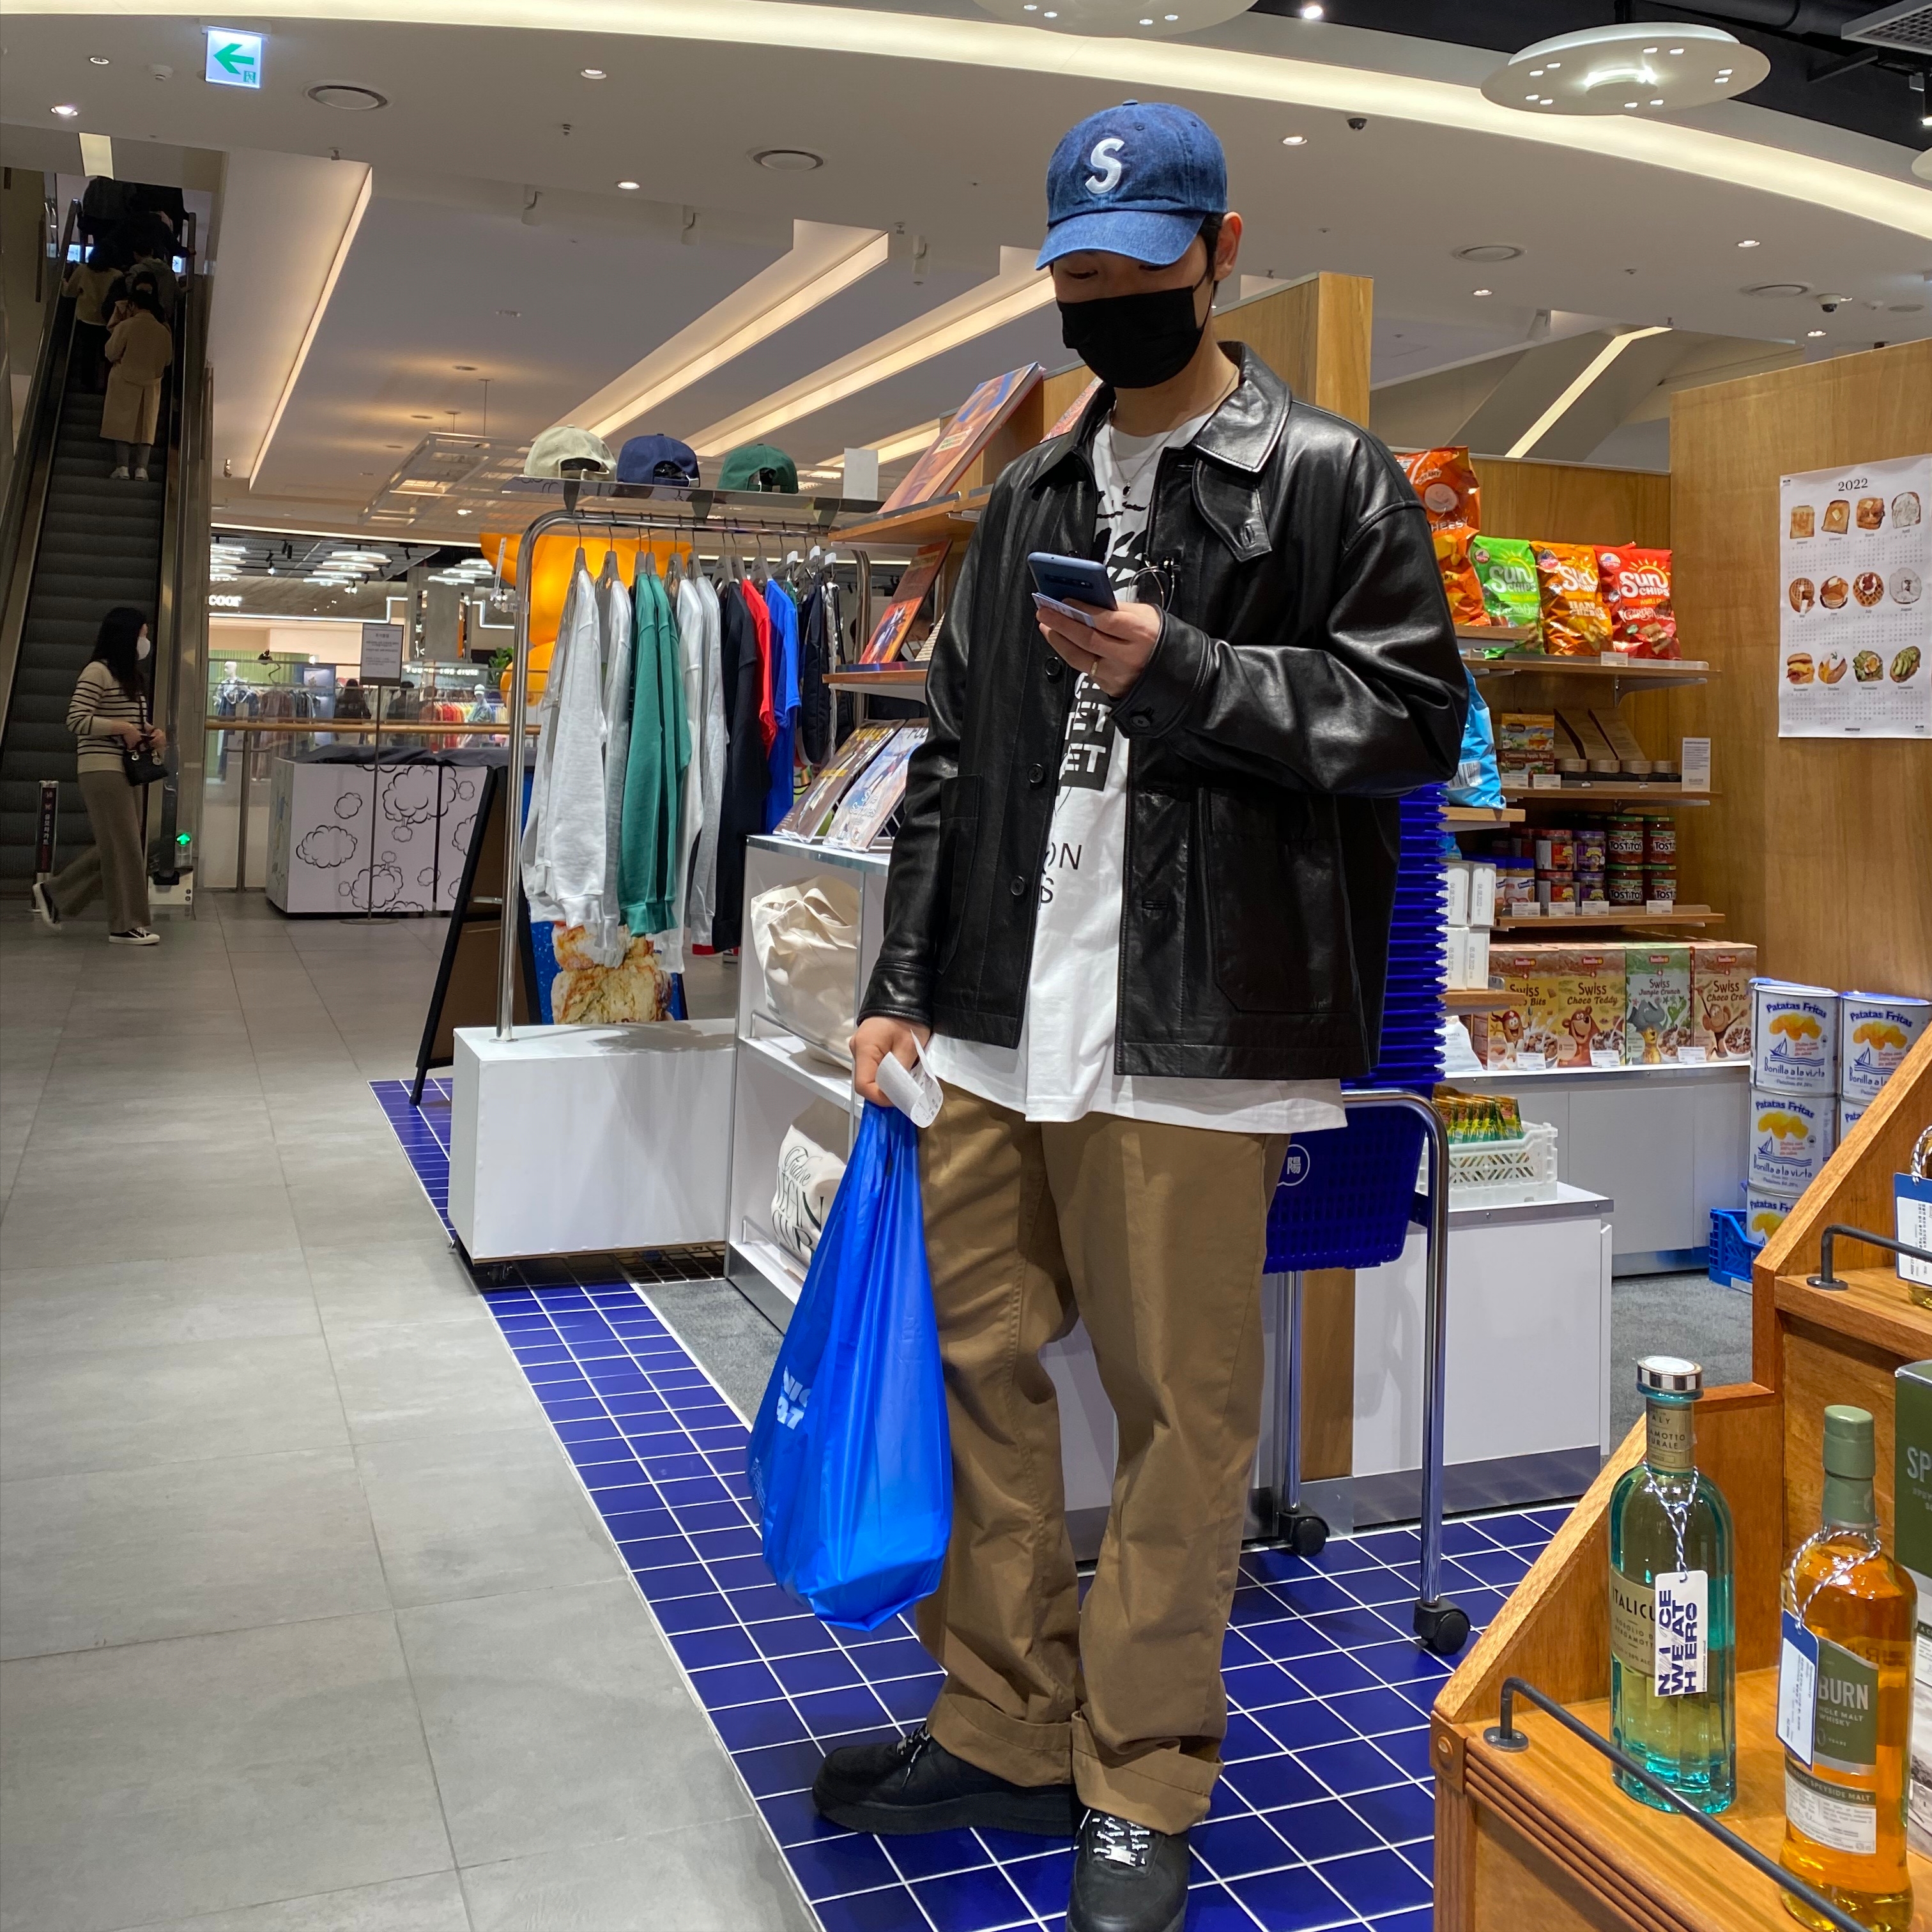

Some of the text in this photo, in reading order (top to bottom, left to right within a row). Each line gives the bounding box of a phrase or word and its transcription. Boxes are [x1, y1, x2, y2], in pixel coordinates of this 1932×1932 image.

[1084, 137, 1125, 194] S
[1417, 470, 1441, 484] CREAMY
[1838, 478, 1868, 491] 2022
[1489, 565, 1534, 593] Sun
[1560, 565, 1598, 592] Sun
[1619, 571, 1668, 598] Sun
[1507, 583, 1537, 592] CHIPS
[1579, 584, 1597, 592] CHIP
[1639, 587, 1669, 597] CHIPS
[1578, 982, 1607, 995] Swiss
[1649, 978, 1670, 988] Swiss
[1713, 980, 1740, 992] Swiss
[1639, 989, 1659, 997] Jungle
[1706, 993, 1729, 1002] Choco
[1530, 998, 1546, 1006] Bits
[1567, 995, 1618, 1006] Choco Teddy
[1766, 1001, 1827, 1018] Patatas Fritas
[1850, 1009, 1913, 1028] Patatas Fritas
[1764, 1056, 1789, 1075] Bonilla
[1797, 1066, 1804, 1076] la
[1806, 1068, 1825, 1078] vista
[1849, 1066, 1873, 1085] Bonilla
[1756, 1100, 1815, 1119] Patatas Fritas
[1753, 1153, 1774, 1174] Bonilla
[1782, 1165, 1789, 1176] la
[1791, 1167, 1813, 1179] vista
[1750, 1199, 1777, 1212] Patatas
[1649, 1429, 1685, 1441] AMOTTO
[1612, 1584, 1655, 1622] ITALICU
[1614, 1624, 1653, 1648] BERGAMOTT
[1818, 1677, 1869, 1710] BURN
[1819, 1715, 1851, 1727] WHISKY
[1841, 1712, 1864, 1722] MALT
[1811, 1778, 1846, 1798] SPEYSIDE
[1848, 1793, 1871, 1802] MALT
